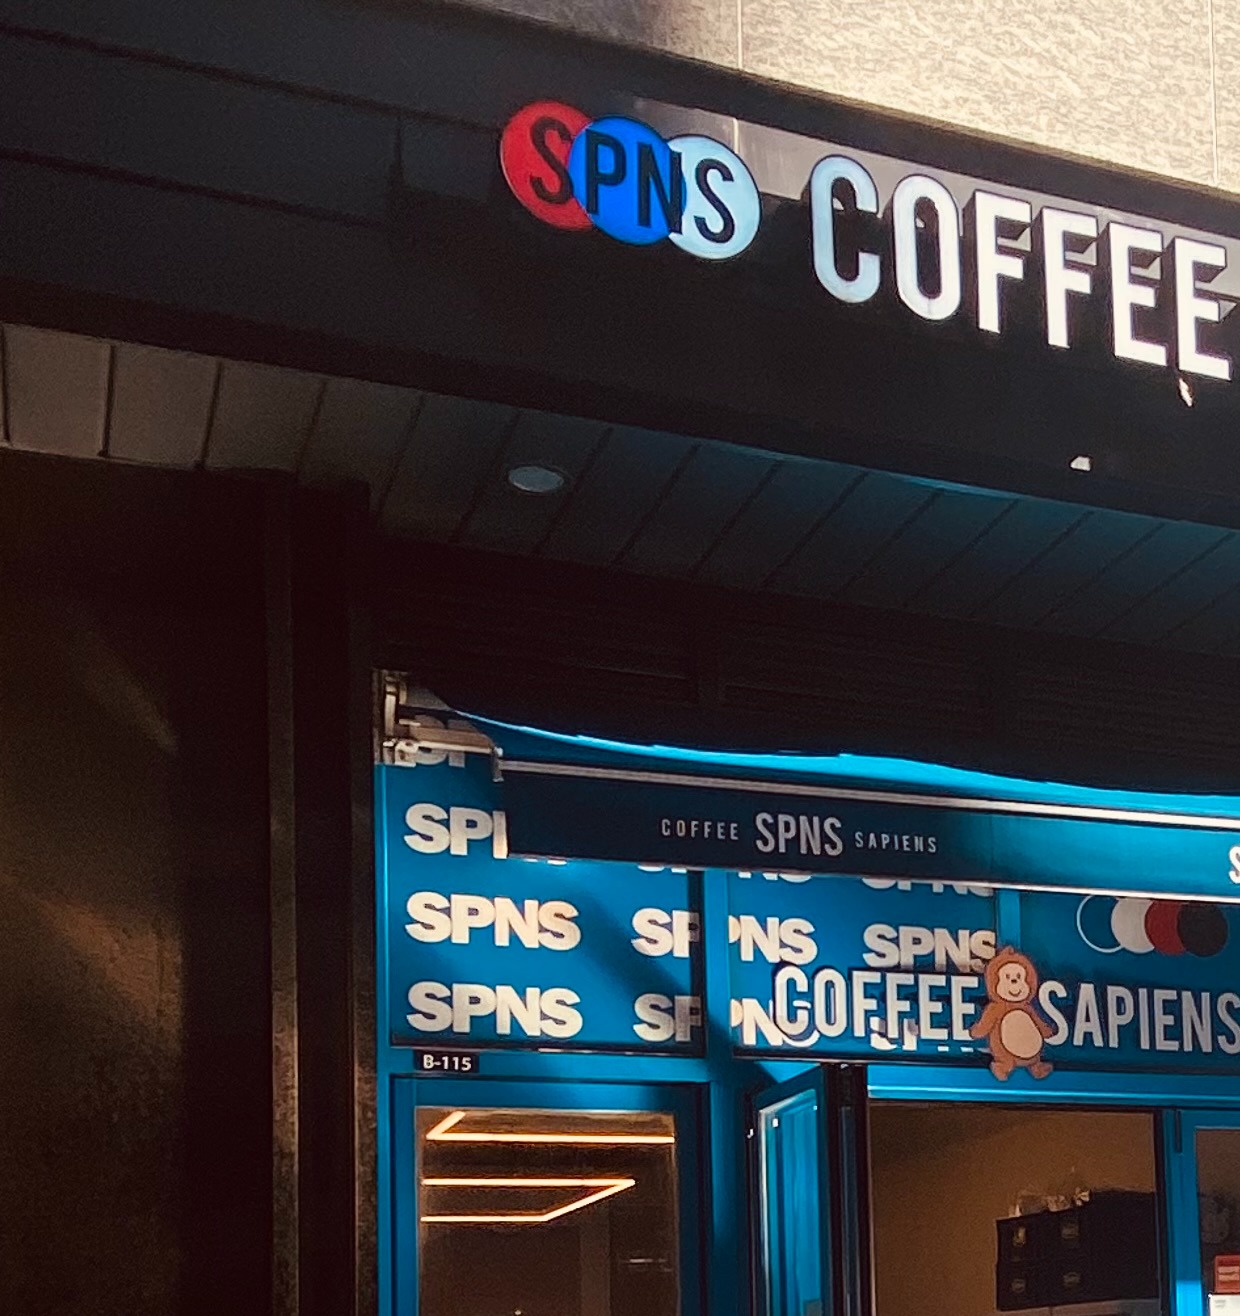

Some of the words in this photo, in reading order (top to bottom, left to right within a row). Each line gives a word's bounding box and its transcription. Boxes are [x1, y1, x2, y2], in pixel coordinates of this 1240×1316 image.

[530, 114, 737, 244] SPNS
[810, 155, 1232, 382] COFFEE
[404, 803, 508, 859] SP
[661, 818, 739, 841] COFFEE
[755, 812, 843, 856] SPNS
[855, 831, 938, 853] SAPIENS
[405, 891, 581, 951] SPNS
[728, 915, 818, 965] NS
[863, 923, 998, 973] SPNS
[406, 981, 583, 1037] SPNS
[775, 965, 980, 1041] COFFEE
[422, 1053, 472, 1072] B-115
